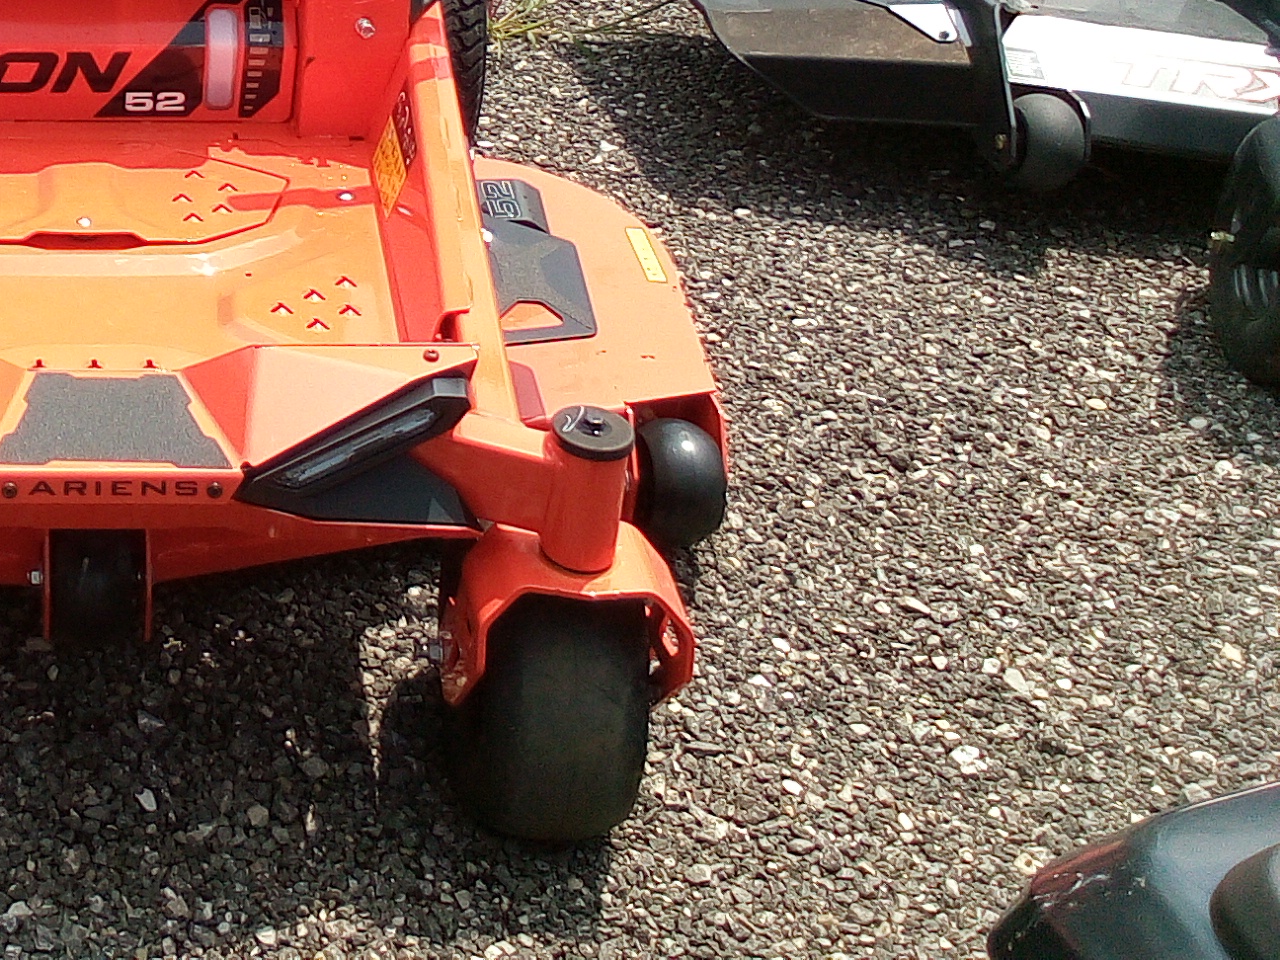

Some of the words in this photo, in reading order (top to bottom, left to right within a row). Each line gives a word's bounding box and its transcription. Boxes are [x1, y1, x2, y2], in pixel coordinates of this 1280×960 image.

[124, 91, 186, 112] 52
[481, 181, 521, 218] 52
[28, 480, 198, 496] ARIENS
